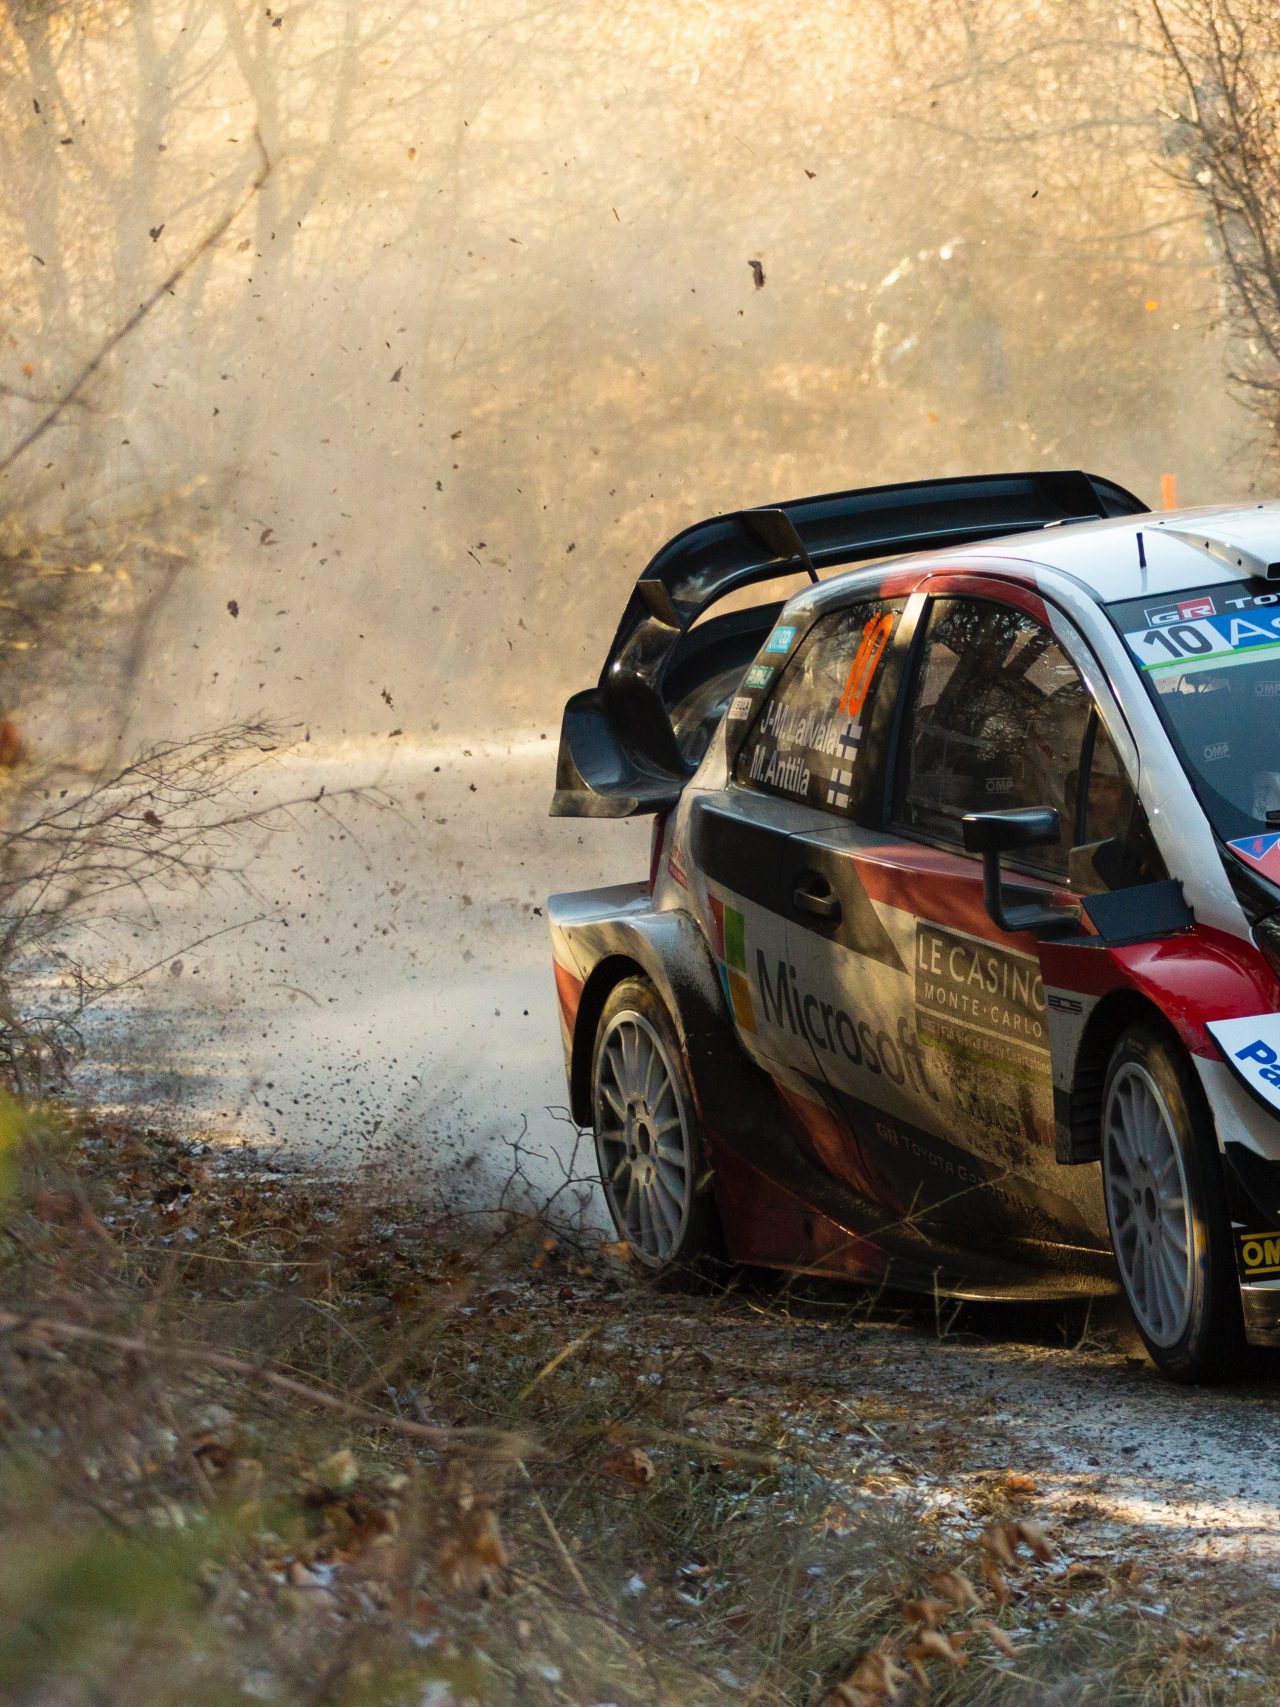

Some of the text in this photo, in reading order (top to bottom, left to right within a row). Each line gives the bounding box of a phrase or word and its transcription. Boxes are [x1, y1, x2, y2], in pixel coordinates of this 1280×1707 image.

[1152, 605, 1212, 625] GR
[1143, 625, 1214, 659] 10
[838, 611, 893, 717] 10
[1204, 744, 1230, 759] OMP
[919, 934, 943, 975] LE
[756, 948, 940, 1102] Microsoft
